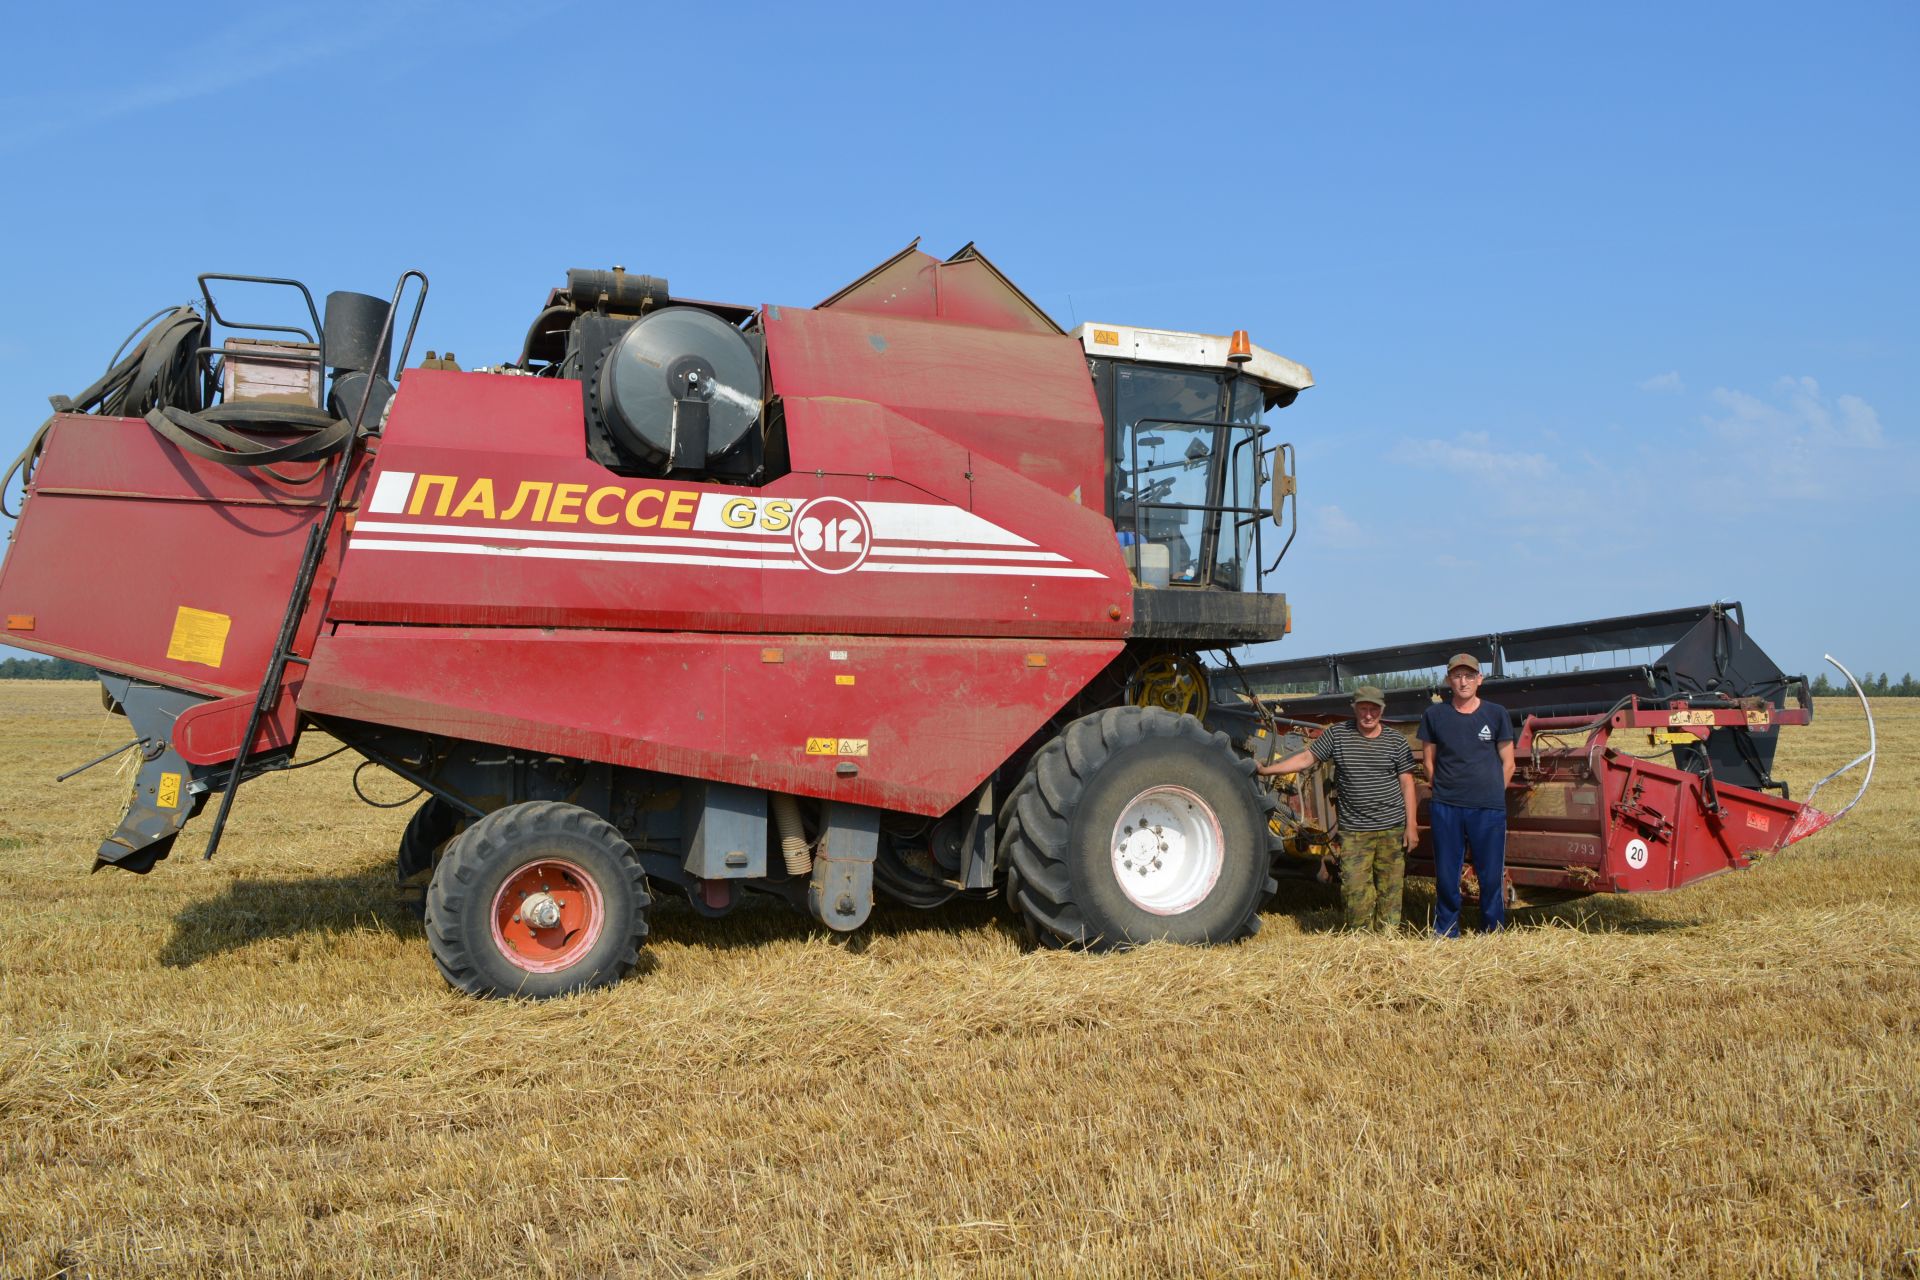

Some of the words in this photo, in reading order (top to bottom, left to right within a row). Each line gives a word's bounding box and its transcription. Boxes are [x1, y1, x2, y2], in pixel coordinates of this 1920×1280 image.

[408, 474, 699, 531] ПАЛЕССЕ
[721, 498, 793, 532] GS
[799, 517, 863, 553] 812
[1567, 841, 1595, 856] 2793
[1631, 846, 1644, 862] 20
